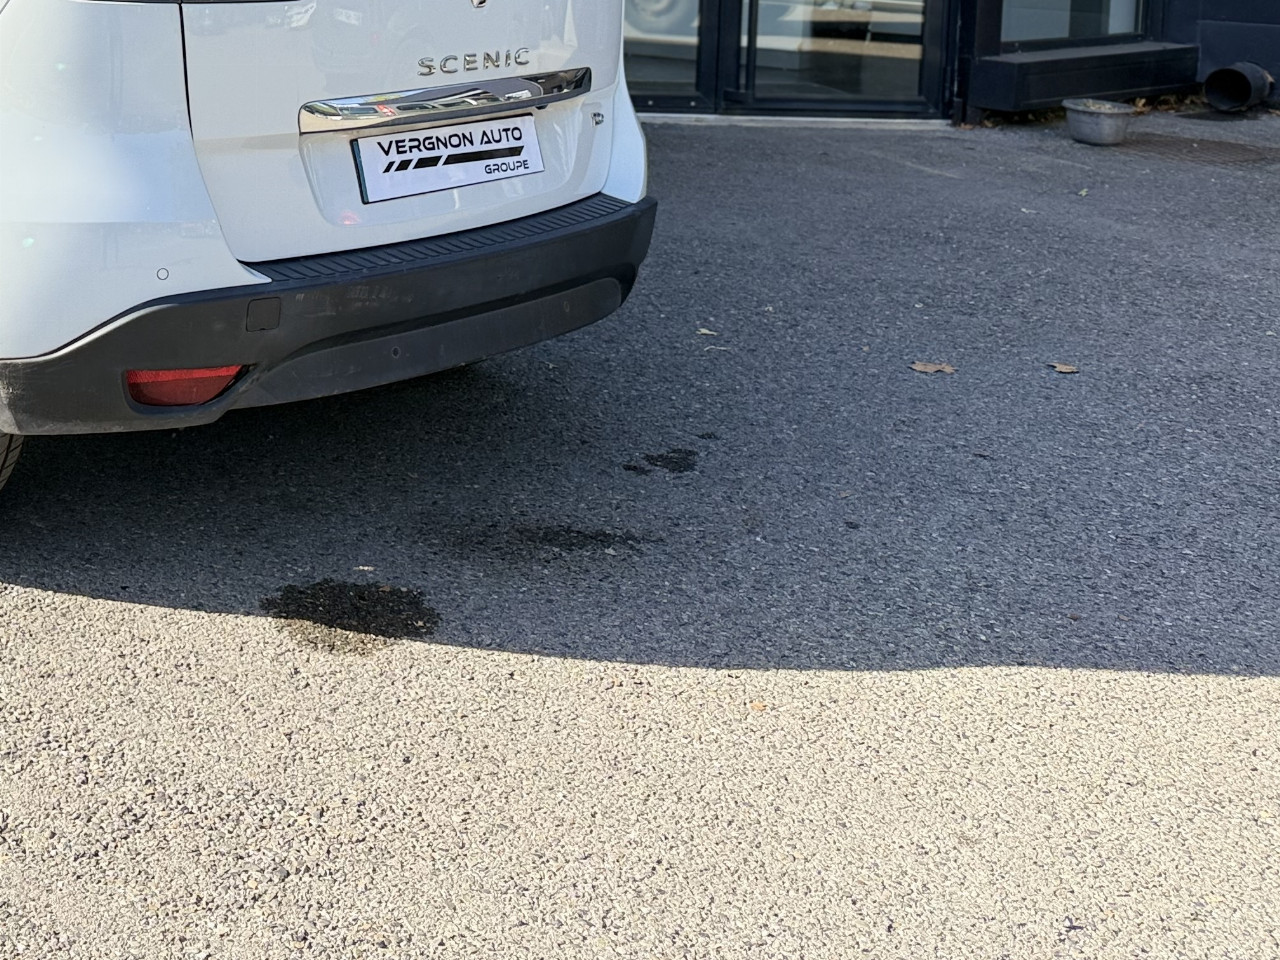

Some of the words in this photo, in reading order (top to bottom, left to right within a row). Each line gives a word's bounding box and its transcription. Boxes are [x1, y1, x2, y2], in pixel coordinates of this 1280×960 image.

[417, 47, 530, 76] SCENIC
[377, 131, 474, 157] VERGNON
[479, 126, 523, 146] AUTO
[484, 159, 529, 175] GROUPE
